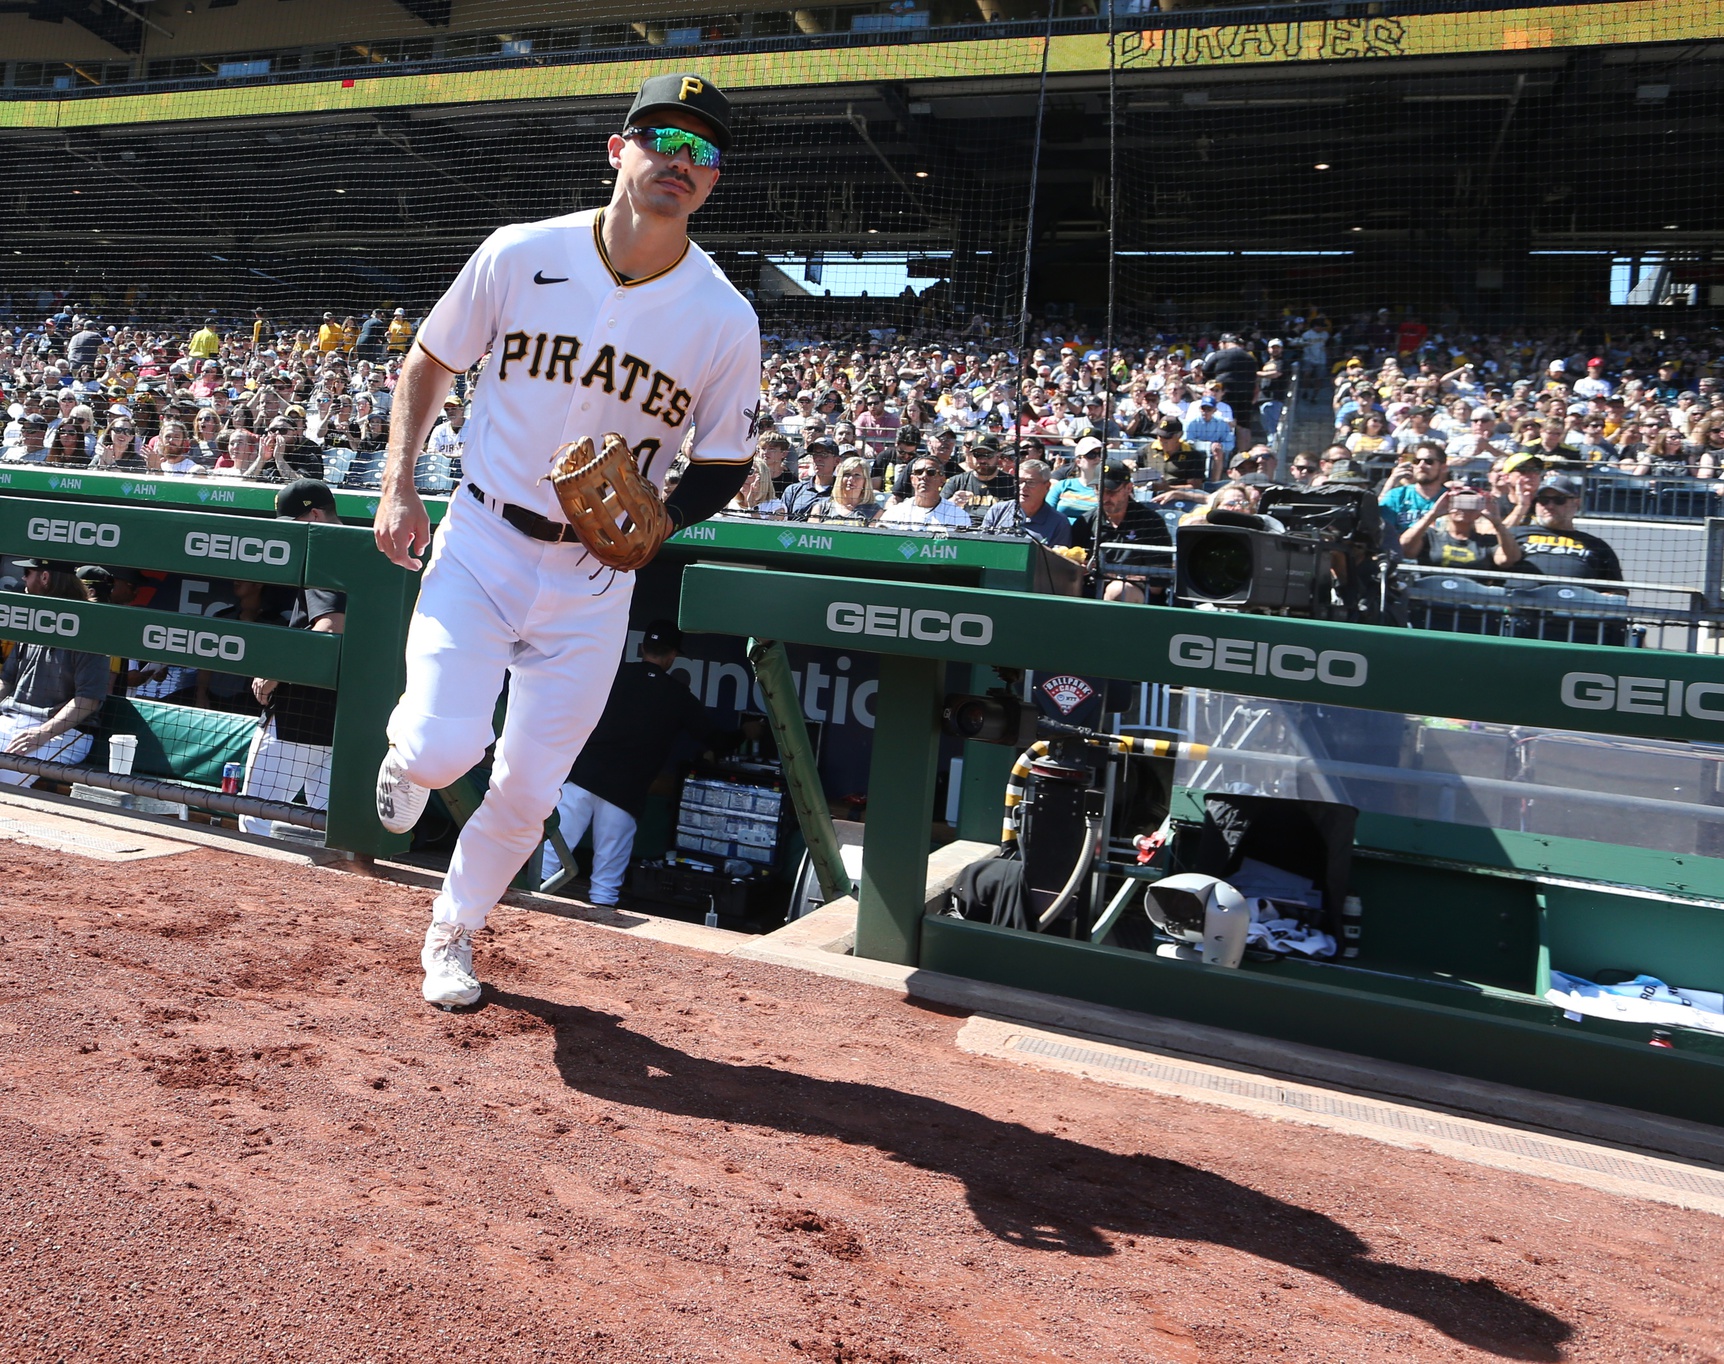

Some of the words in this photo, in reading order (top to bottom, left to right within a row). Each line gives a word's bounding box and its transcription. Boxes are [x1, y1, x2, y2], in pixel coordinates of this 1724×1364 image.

[678, 76, 703, 100] P
[498, 330, 692, 428] PIRATES
[60, 478, 82, 490] AHN
[133, 484, 157, 496] AHN
[210, 490, 235, 503] AHN
[27, 517, 121, 548] GEICO
[683, 527, 716, 542] AHN
[797, 534, 833, 551] AHN
[184, 531, 291, 566] GEICO
[919, 544, 958, 559] AHN
[826, 601, 994, 646] GEICO
[142, 624, 246, 662] GEICO
[1168, 633, 1369, 688] GEICO
[1045, 677, 1092, 695] BALLPARK
[1059, 684, 1078, 693] CAM
[1560, 671, 1724, 722] GEIC
